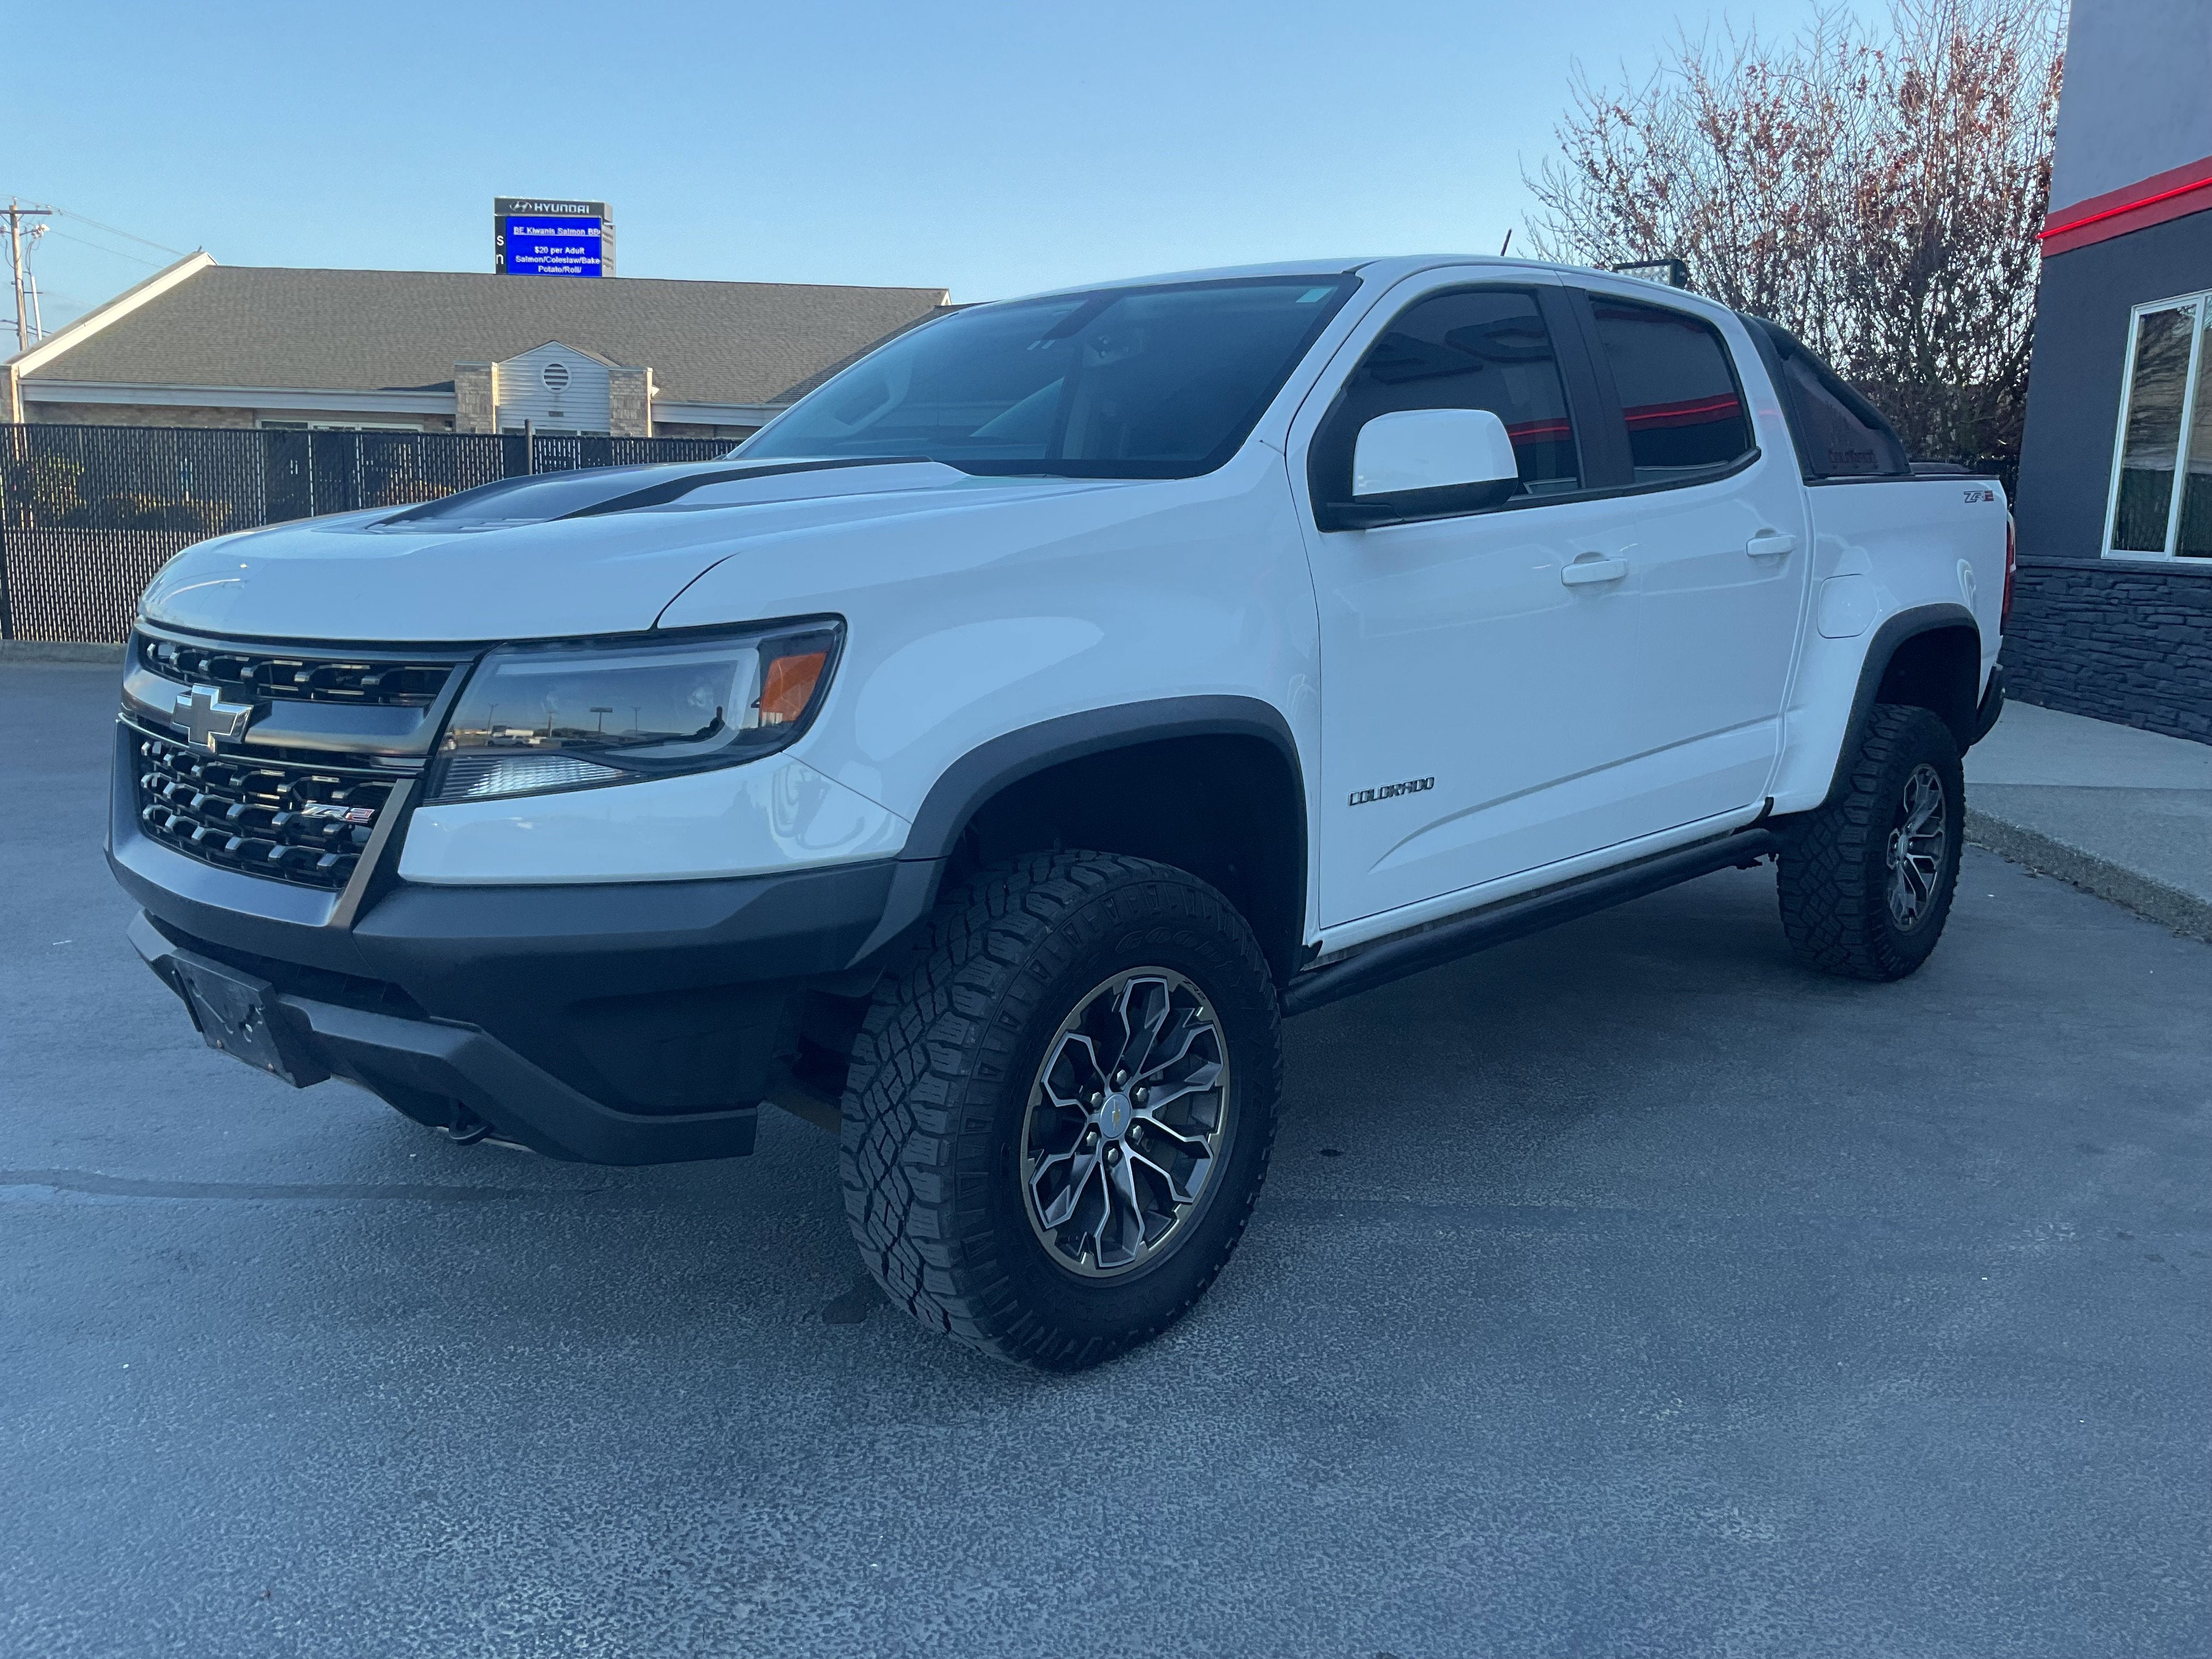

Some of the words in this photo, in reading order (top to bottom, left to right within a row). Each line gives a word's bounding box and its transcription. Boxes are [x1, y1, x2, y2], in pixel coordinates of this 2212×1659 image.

[534, 202, 589, 214] HYUNDAI
[527, 227, 555, 235] Kiwanis
[557, 228, 585, 236] Salmon
[1963, 490, 1994, 503] ZR2
[1347, 775, 1435, 806] COLORADO
[301, 803, 375, 823] ZR2
